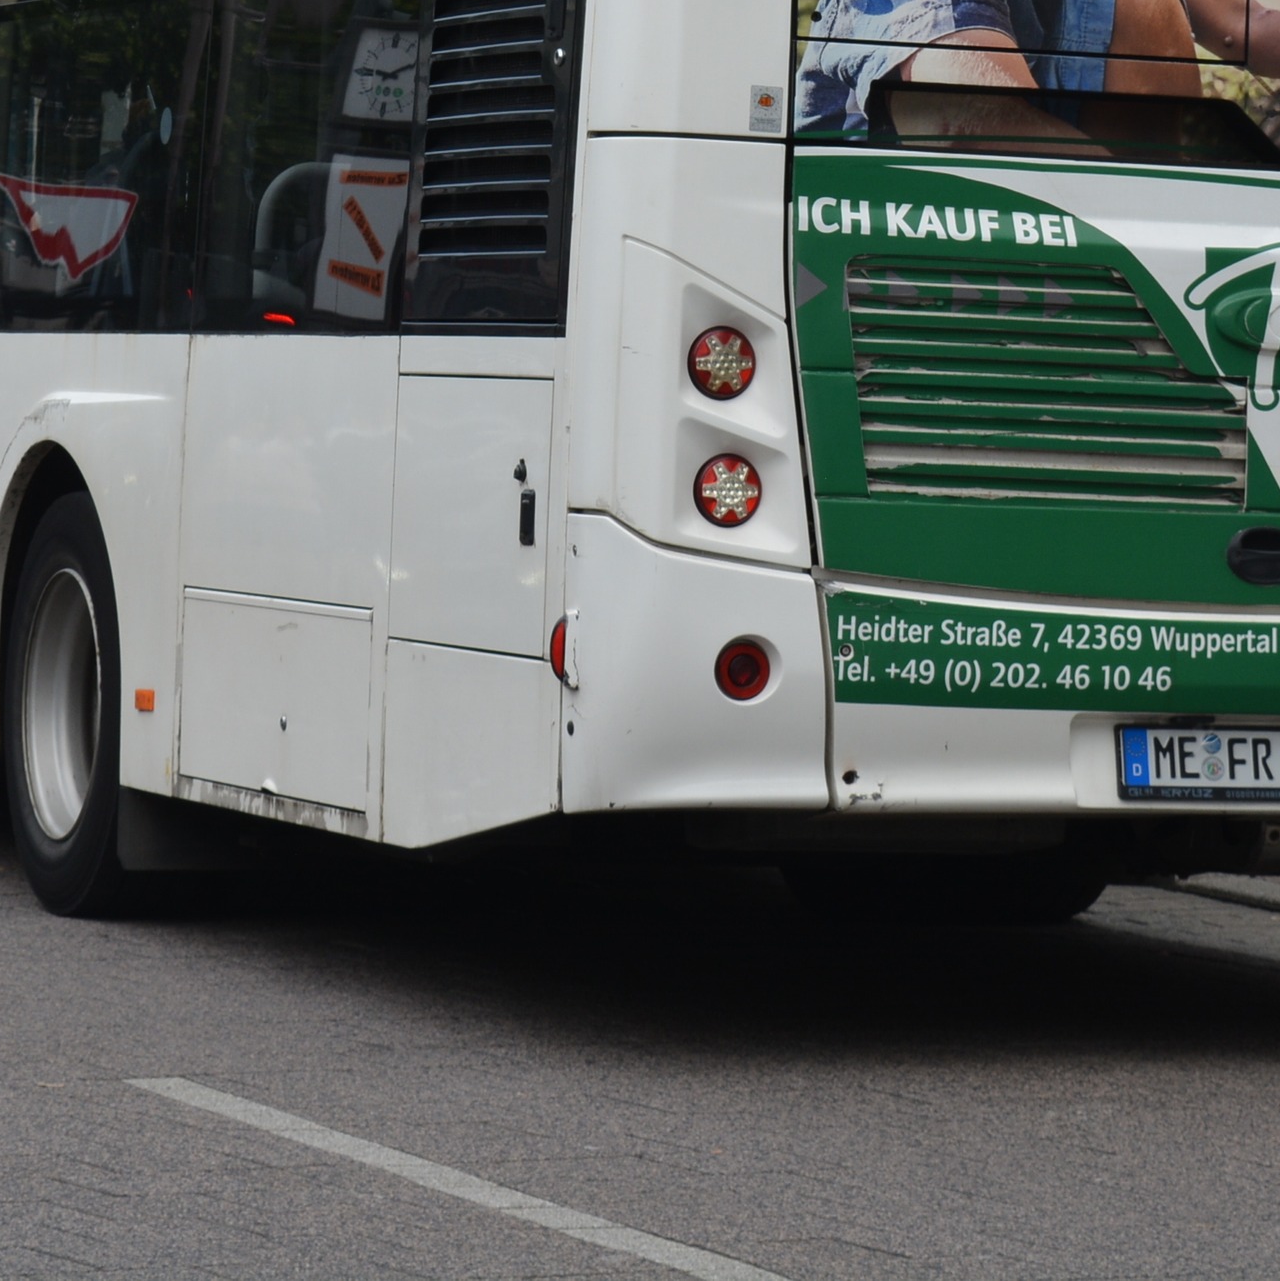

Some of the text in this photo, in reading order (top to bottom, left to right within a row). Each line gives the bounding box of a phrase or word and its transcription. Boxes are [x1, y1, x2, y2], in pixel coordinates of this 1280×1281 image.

[798, 196, 1077, 247] ICH KAUF BEI
[837, 615, 1278, 658] Heidter Straße 7, 42369 Wuppertal
[835, 656, 1172, 692] Tel. +49 (0) 202. 46 10 46
[1132, 763, 1142, 777] D
[1153, 736, 1200, 779] ME
[1227, 738, 1274, 780] FR
